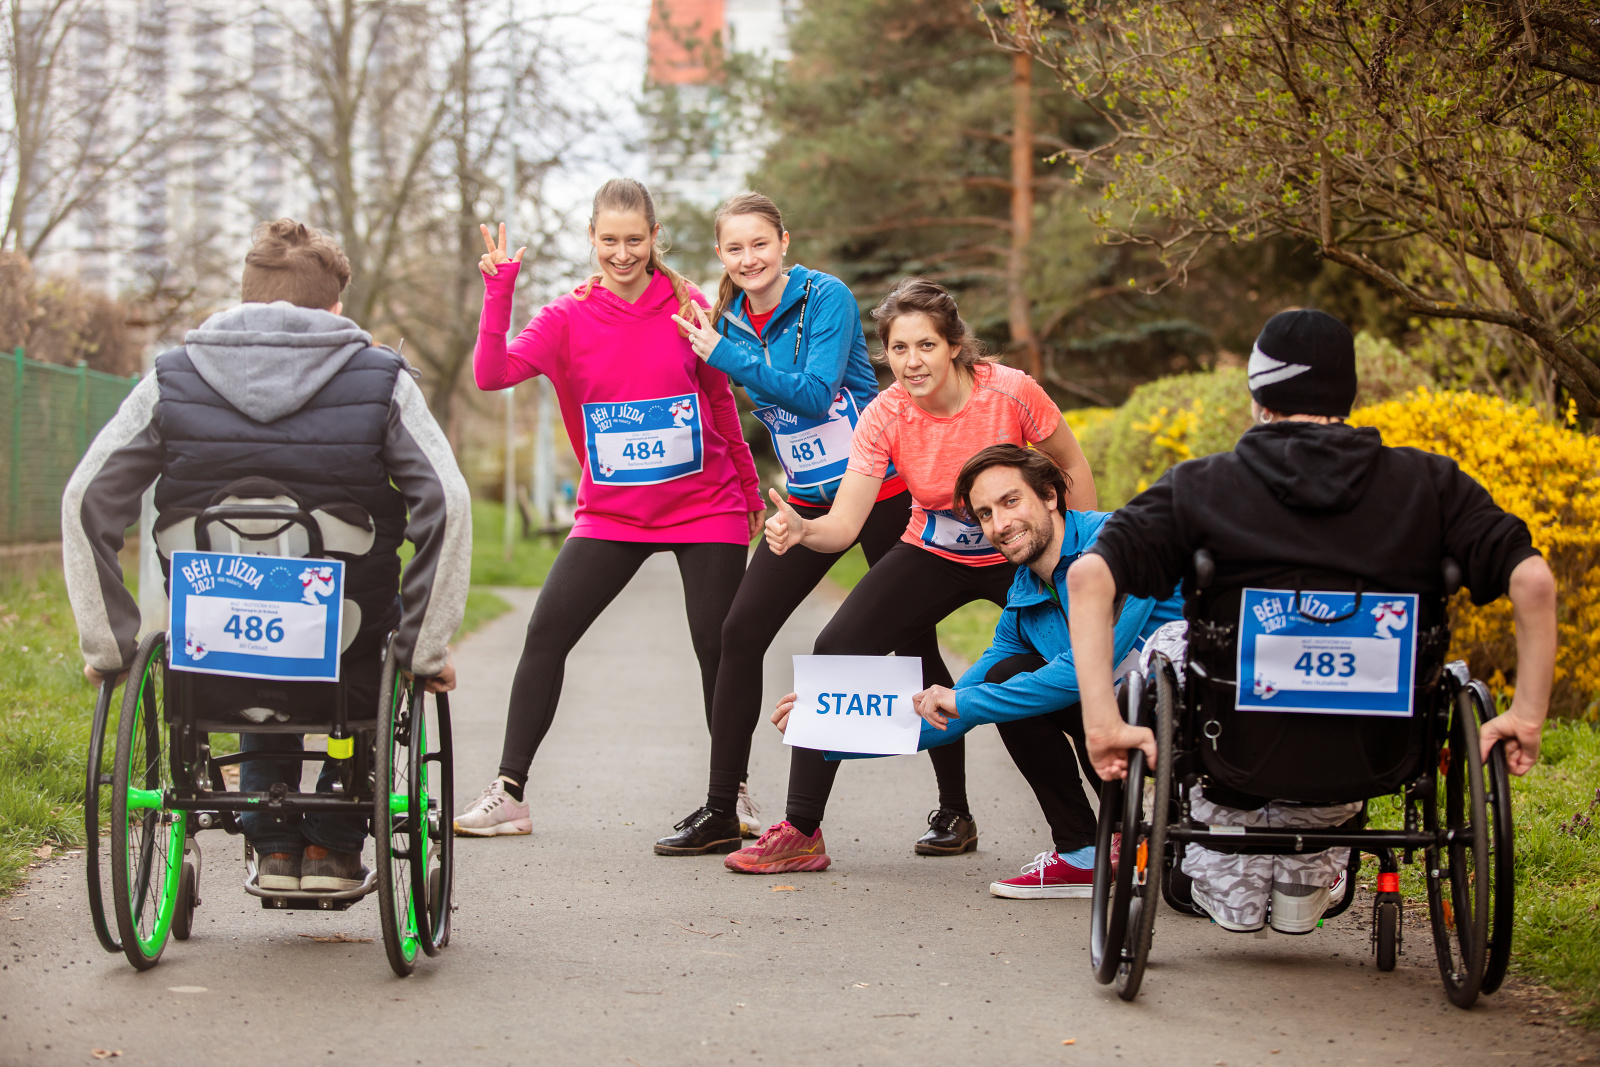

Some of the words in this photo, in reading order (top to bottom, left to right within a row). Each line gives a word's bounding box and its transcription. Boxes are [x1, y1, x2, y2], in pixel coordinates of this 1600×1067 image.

[590, 407, 609, 424] BĚH
[611, 406, 615, 417] I
[618, 404, 645, 424] JÍZDA
[597, 419, 612, 432] 2021
[623, 440, 666, 460] 484
[791, 438, 826, 462] 481
[181, 559, 212, 583] BĚH
[216, 558, 224, 574] I
[225, 557, 264, 590] JÍZDA
[191, 576, 215, 595] 2021
[1252, 597, 1283, 622] BĚH
[1287, 596, 1295, 613] I
[223, 614, 285, 643] 486
[1261, 615, 1287, 634] 2021
[1294, 652, 1356, 677] 483
[816, 692, 898, 716] START
